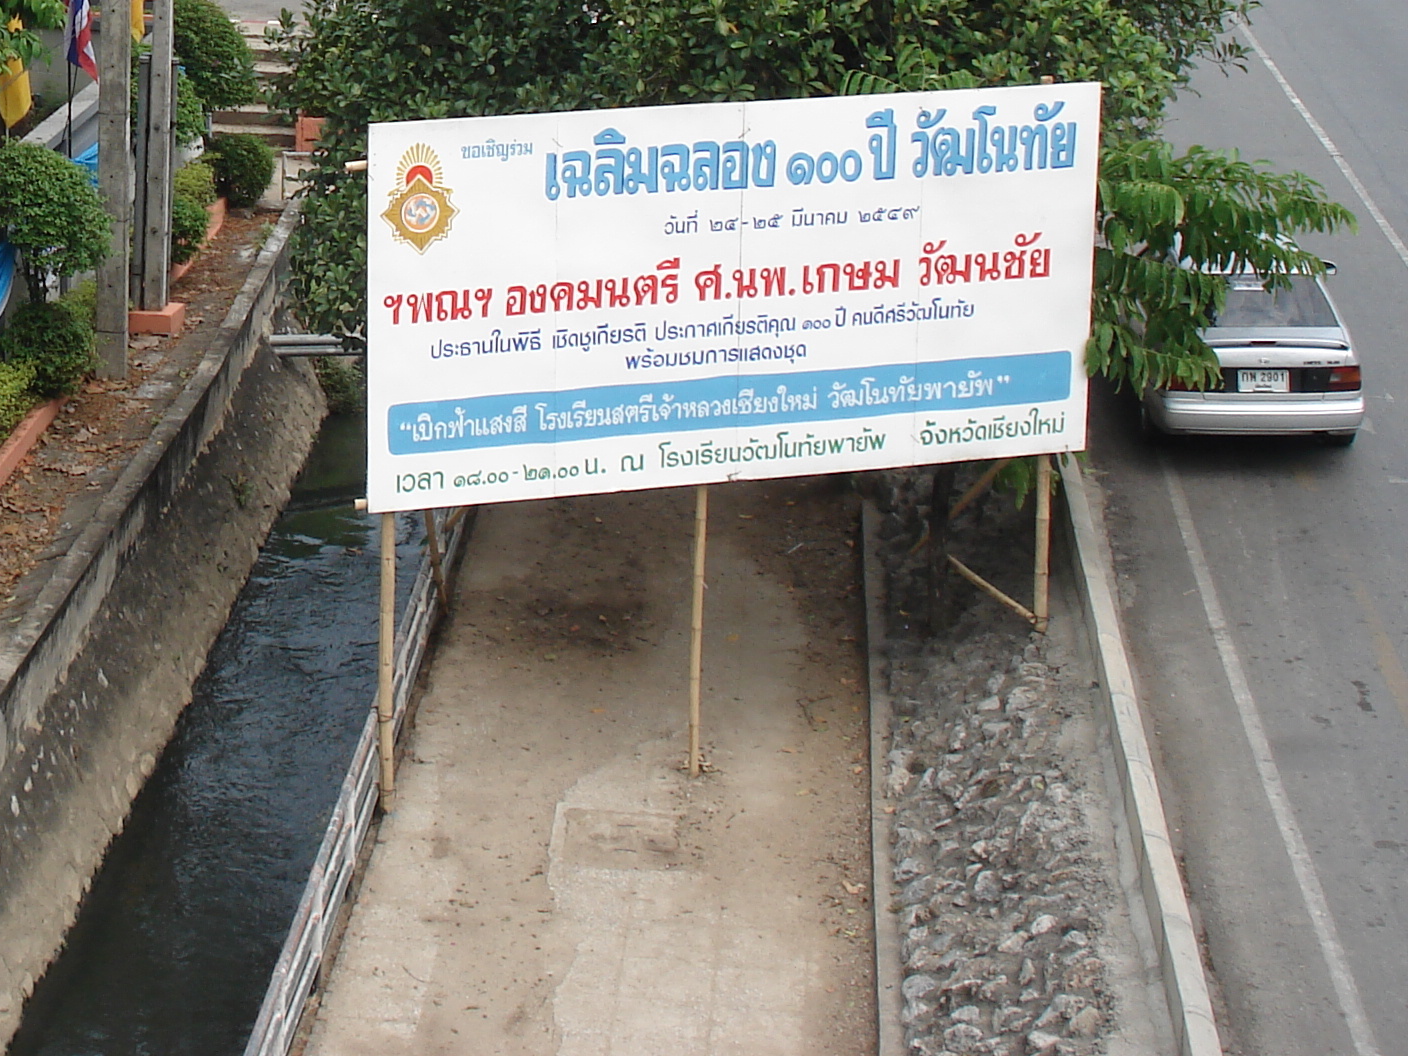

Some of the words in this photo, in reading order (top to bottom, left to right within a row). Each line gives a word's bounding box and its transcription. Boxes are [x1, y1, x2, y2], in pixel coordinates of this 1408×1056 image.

[460, 138, 533, 162] ขอเชิญร่วม
[545, 128, 777, 201] เฉลิมฉลอง
[786, 150, 863, 186] ๑๐๐
[866, 108, 897, 181] ปี
[911, 101, 1078, 178] วัฒโนทัย
[663, 210, 699, 235] วันที่
[791, 208, 848, 228] มีนาคม
[858, 205, 920, 224] ๒๕๔๙
[383, 288, 493, 325] ฯพณฯ
[505, 257, 681, 317] องคมนตรี
[917, 232, 1052, 287] วัฒนชัย
[430, 328, 542, 359] ประธานในพิธี
[552, 322, 647, 352] เชิดชูเกียรติ
[655, 313, 796, 341] ประกาศเกียรติคุณ
[801, 318, 831, 330] ๑๐๐
[835, 307, 847, 328] ปี
[851, 299, 975, 327] คนดีศรีวัฒโนทัย
[625, 343, 807, 371] พร้อมชมการแสดงชุด
[534, 385, 818, 431] โรงเรียนสตรีเจ้าหลวงเชียงใหม่
[396, 470, 444, 493] เวลา
[584, 457, 607, 475] น.
[620, 453, 644, 473] ณ
[657, 427, 887, 468] โรงเรียนวัฒโนทัยพายัพ
[919, 407, 1066, 446] จังหวัดเชียงใหม่
